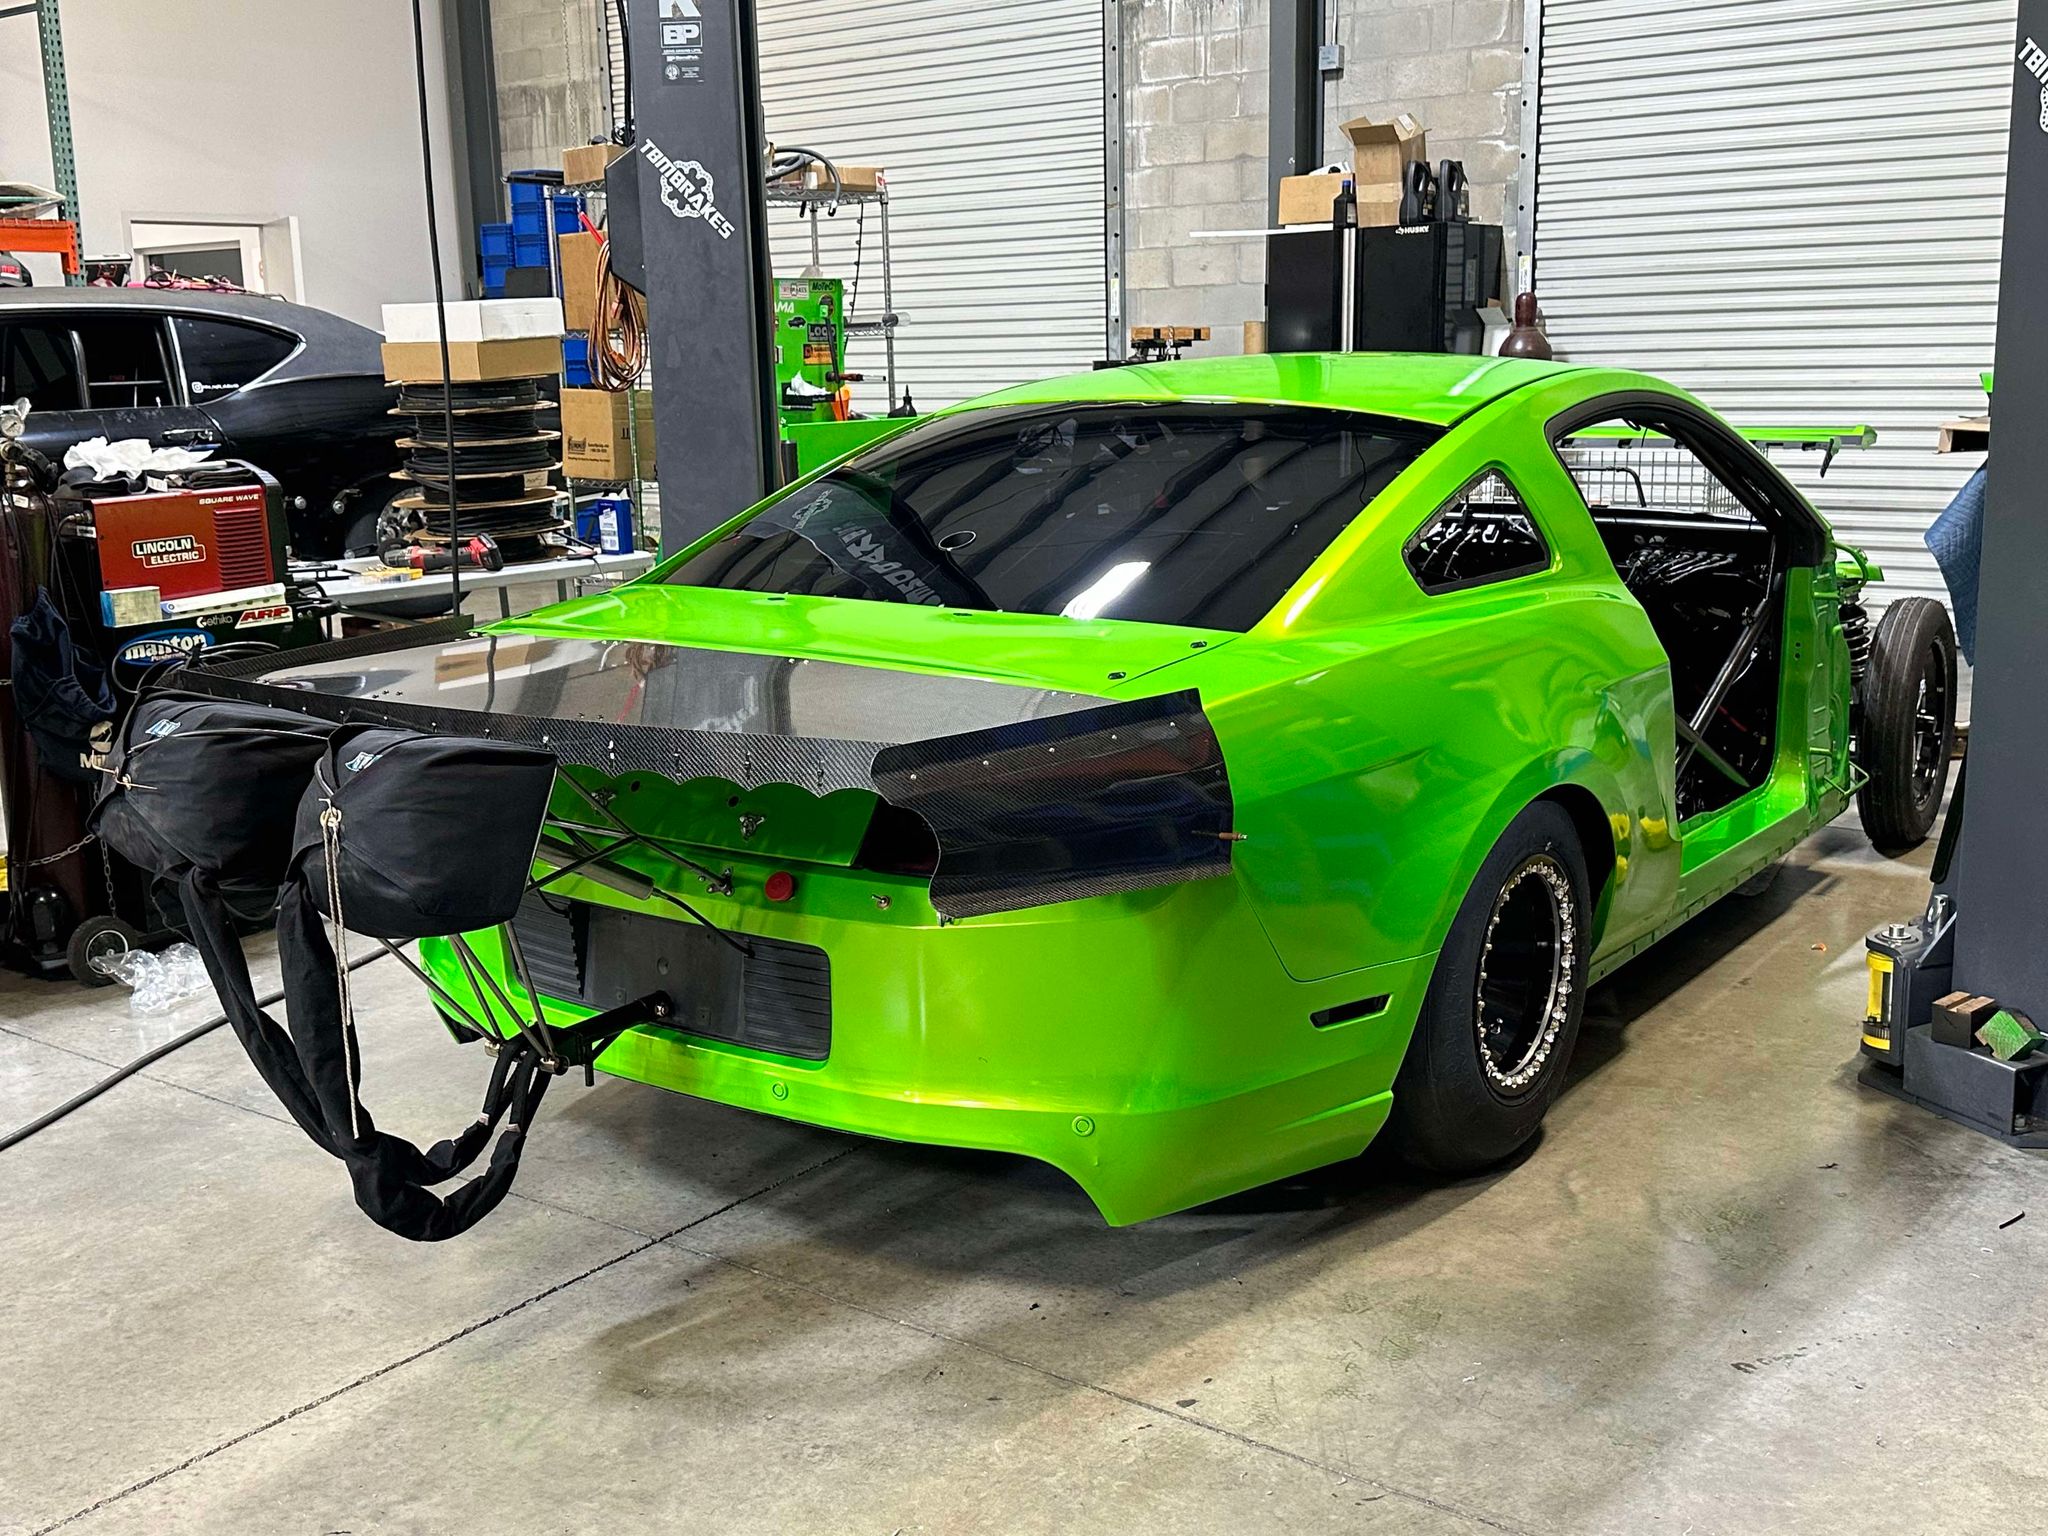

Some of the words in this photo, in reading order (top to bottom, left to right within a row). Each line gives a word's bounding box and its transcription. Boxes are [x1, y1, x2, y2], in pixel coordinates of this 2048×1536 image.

[663, 24, 699, 44] BP
[1404, 225, 1430, 234] HUSKY
[199, 496, 234, 505] SQUARE
[235, 494, 259, 502] WAVE
[135, 538, 192, 556] LINCOLN
[150, 551, 200, 565] ELECTRIC
[207, 615, 234, 626] ethika
[240, 607, 290, 623] ARP
